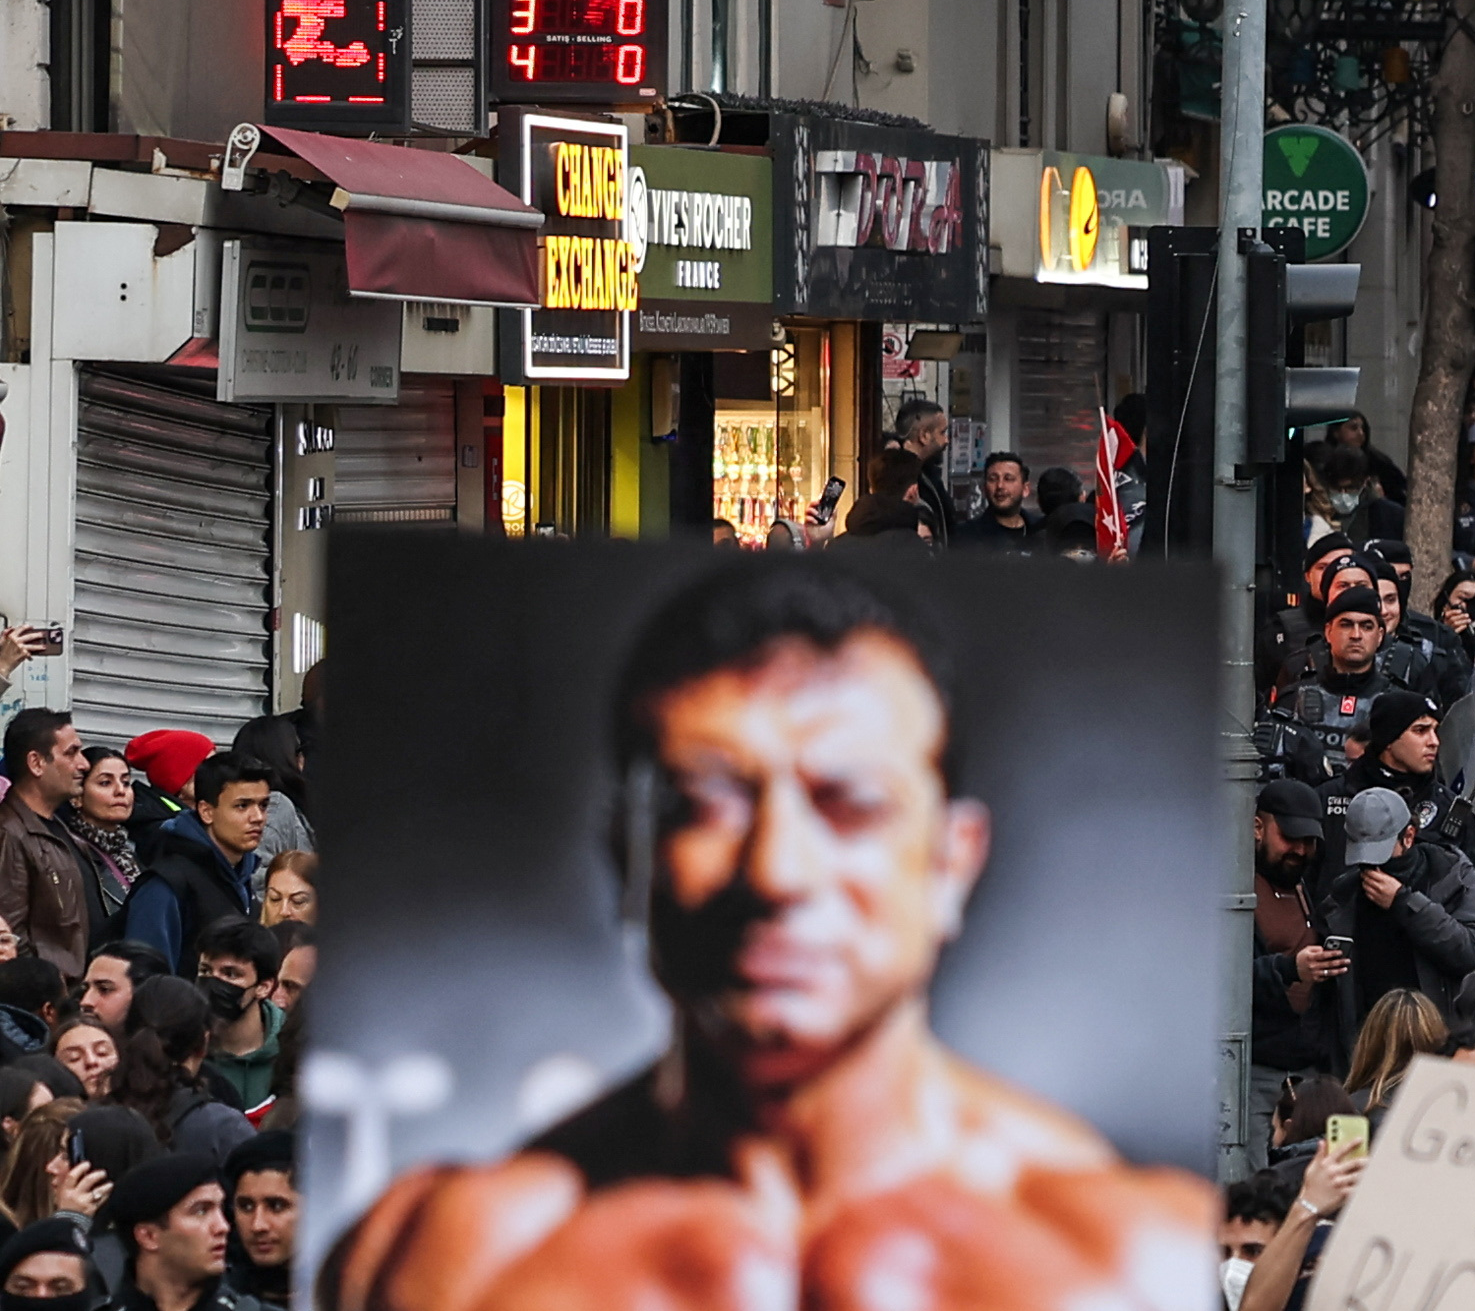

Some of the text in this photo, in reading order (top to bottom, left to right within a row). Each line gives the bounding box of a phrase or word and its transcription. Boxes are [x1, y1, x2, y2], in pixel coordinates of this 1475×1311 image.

[576, 35, 612, 43] SELLING
[556, 141, 625, 221] CHANGE
[651, 189, 752, 251] YVES ROCHER
[545, 235, 639, 312] EXCHANGE
[677, 260, 721, 289] FRANCE
[1327, 805, 1348, 816] POL
